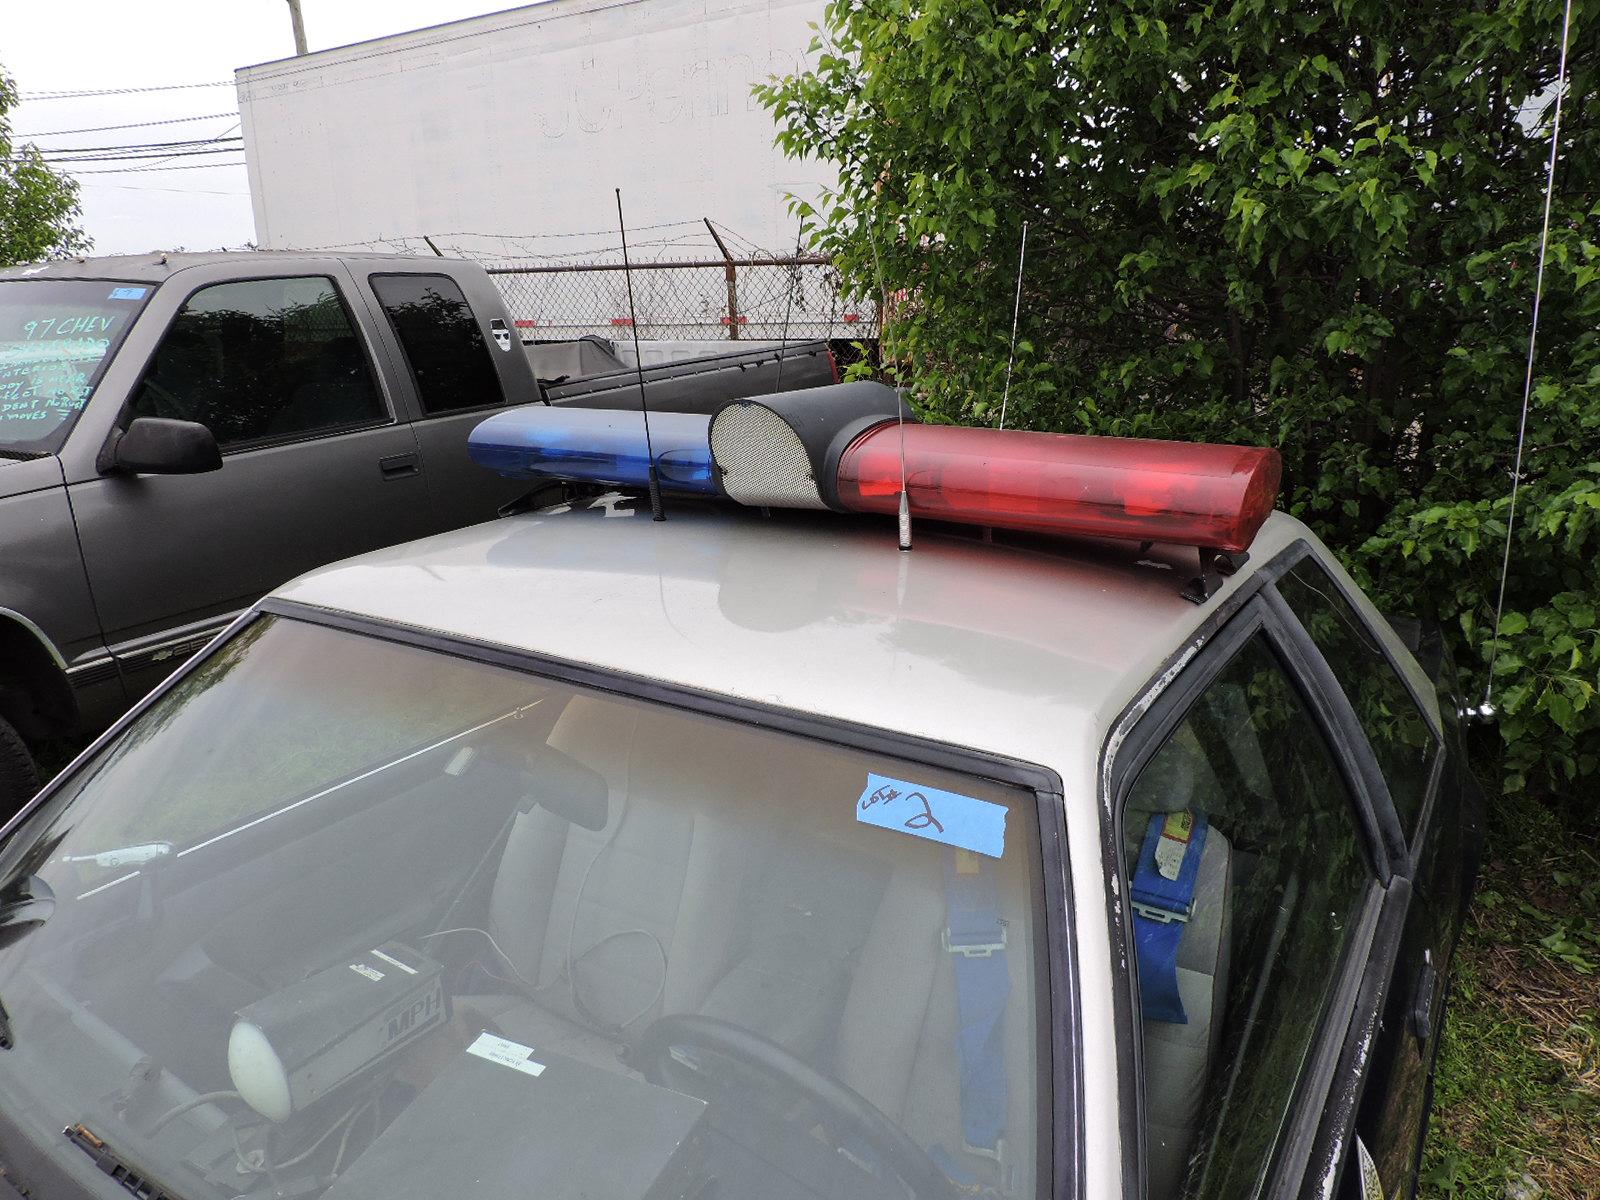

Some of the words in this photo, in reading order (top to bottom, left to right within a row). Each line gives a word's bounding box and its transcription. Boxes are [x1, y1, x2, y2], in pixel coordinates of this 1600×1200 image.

[24, 318, 56, 341] 97
[57, 316, 117, 335] CHEV
[904, 792, 945, 833] 2
[387, 986, 441, 1041] MPH
